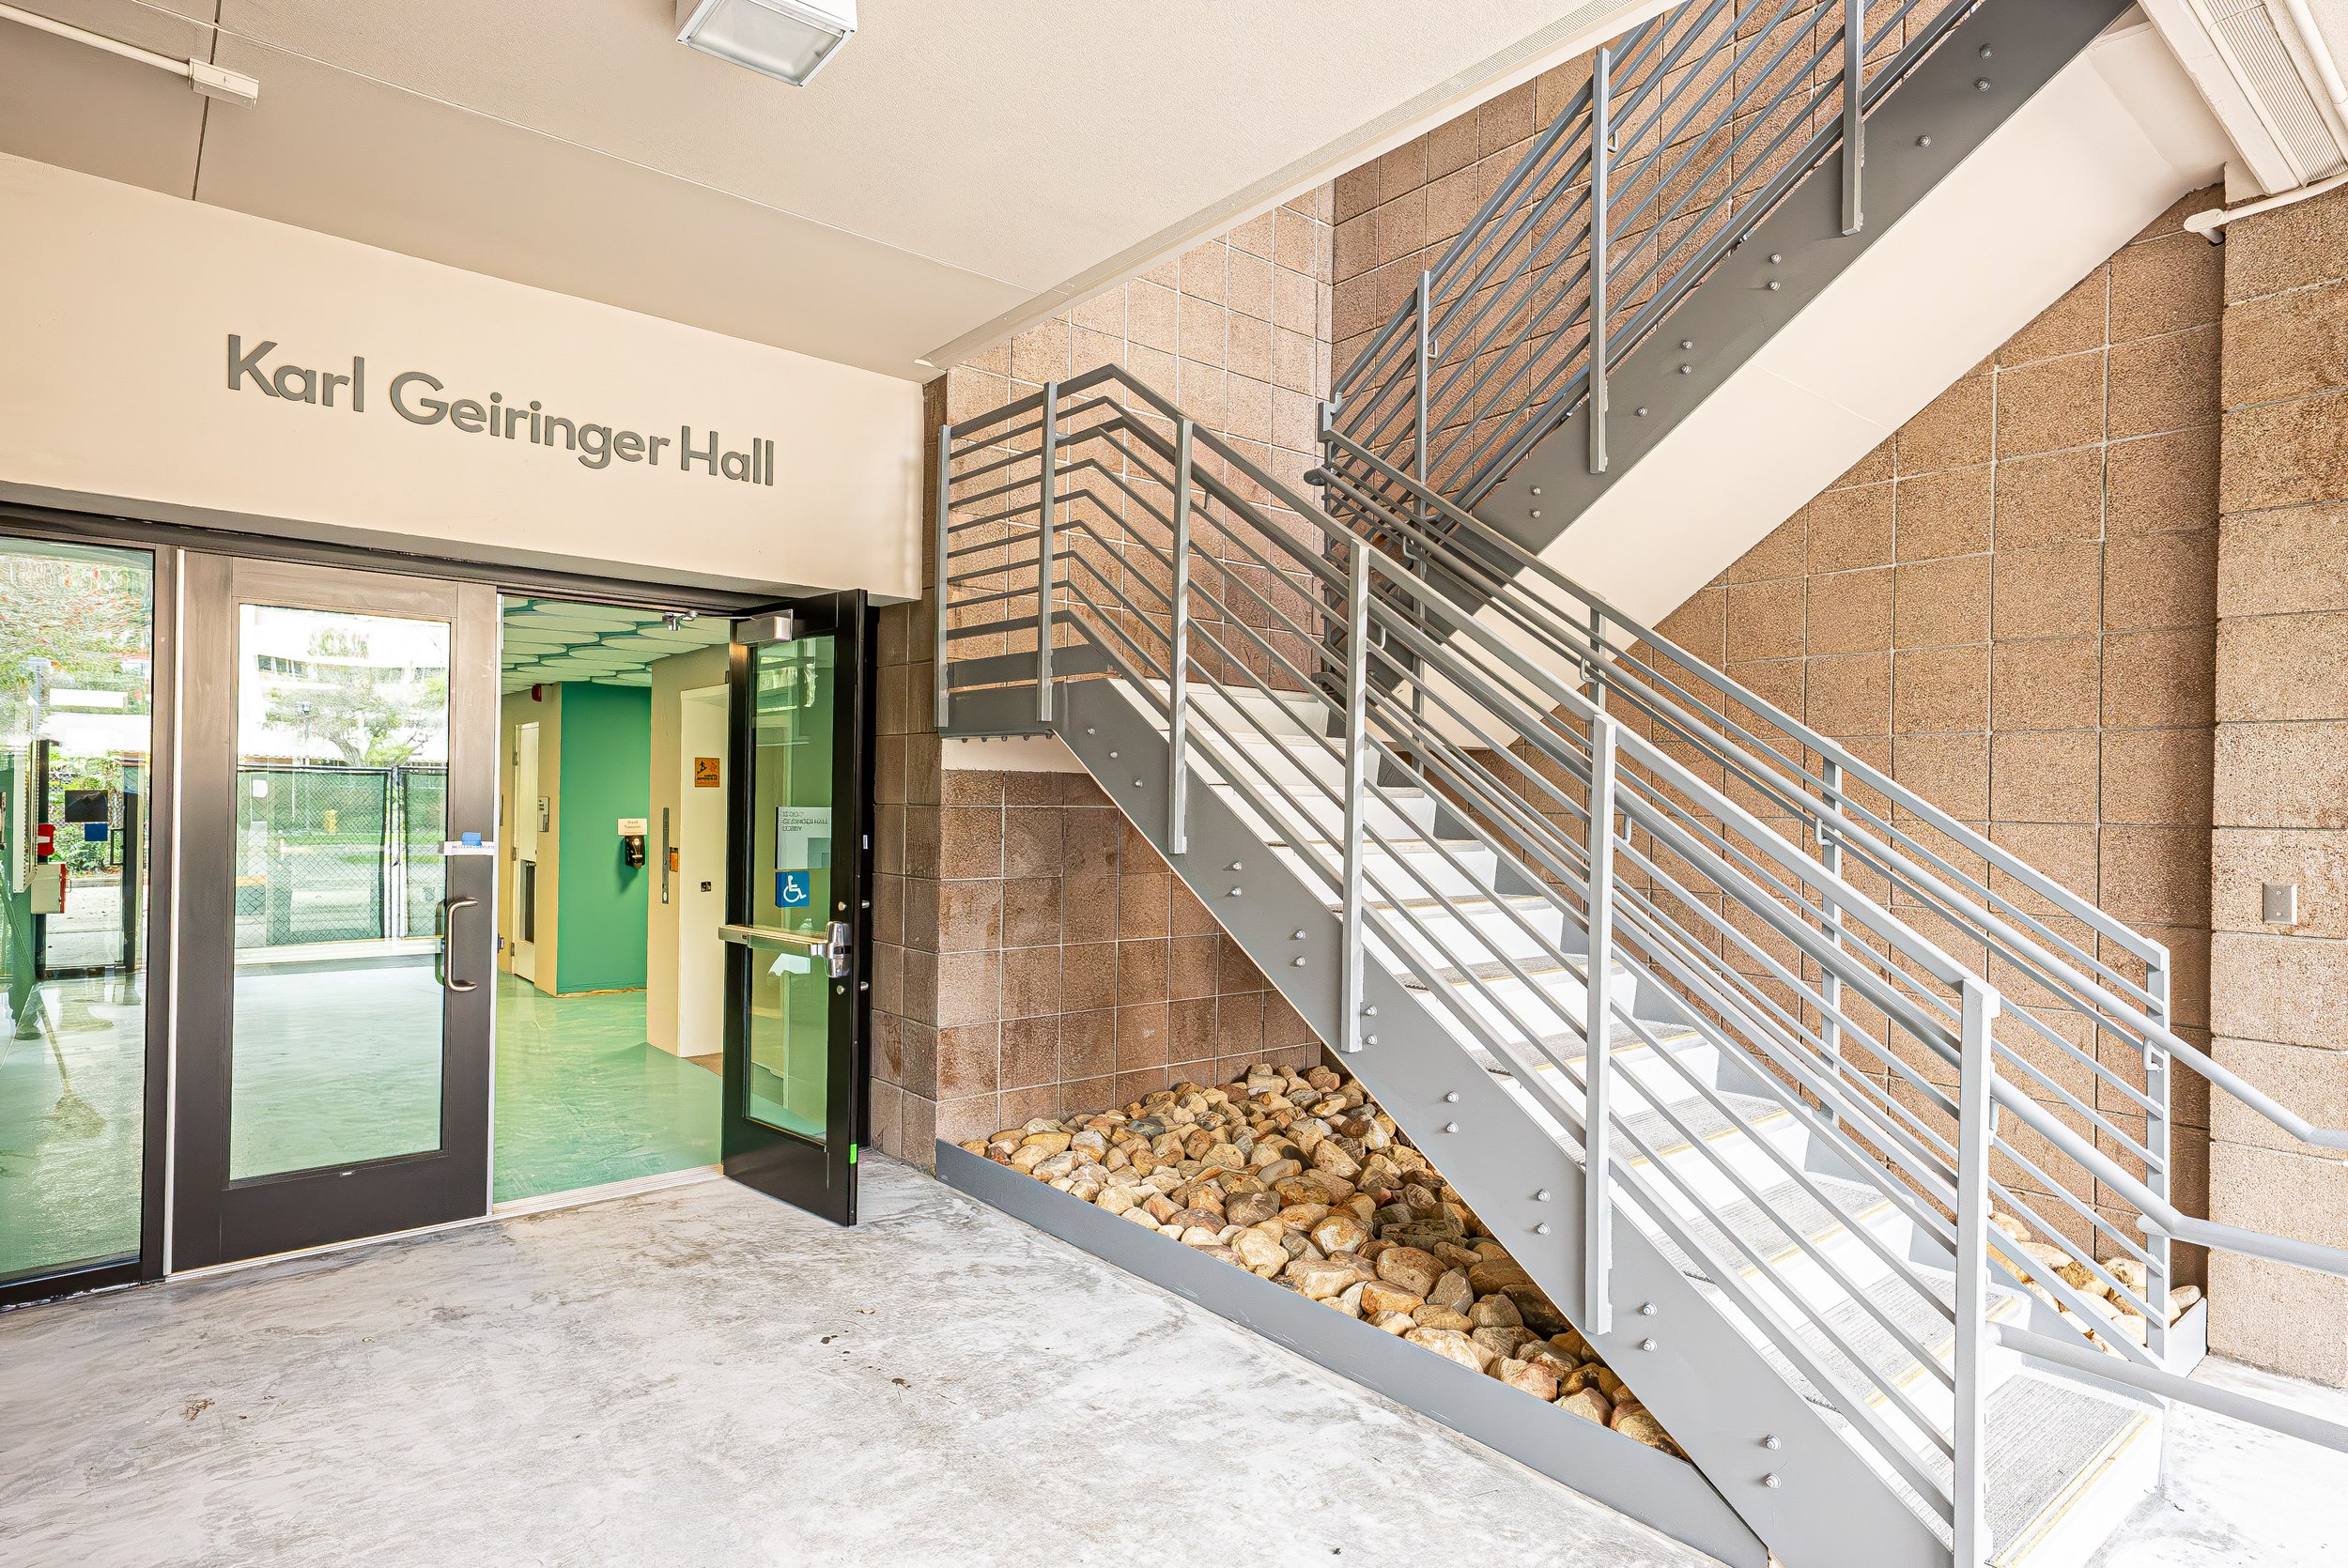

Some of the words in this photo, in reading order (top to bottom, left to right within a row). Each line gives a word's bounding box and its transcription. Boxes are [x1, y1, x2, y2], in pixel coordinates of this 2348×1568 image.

[227, 334, 364, 412] Karl
[390, 371, 671, 469] Geiringer
[680, 425, 775, 487] Hall
